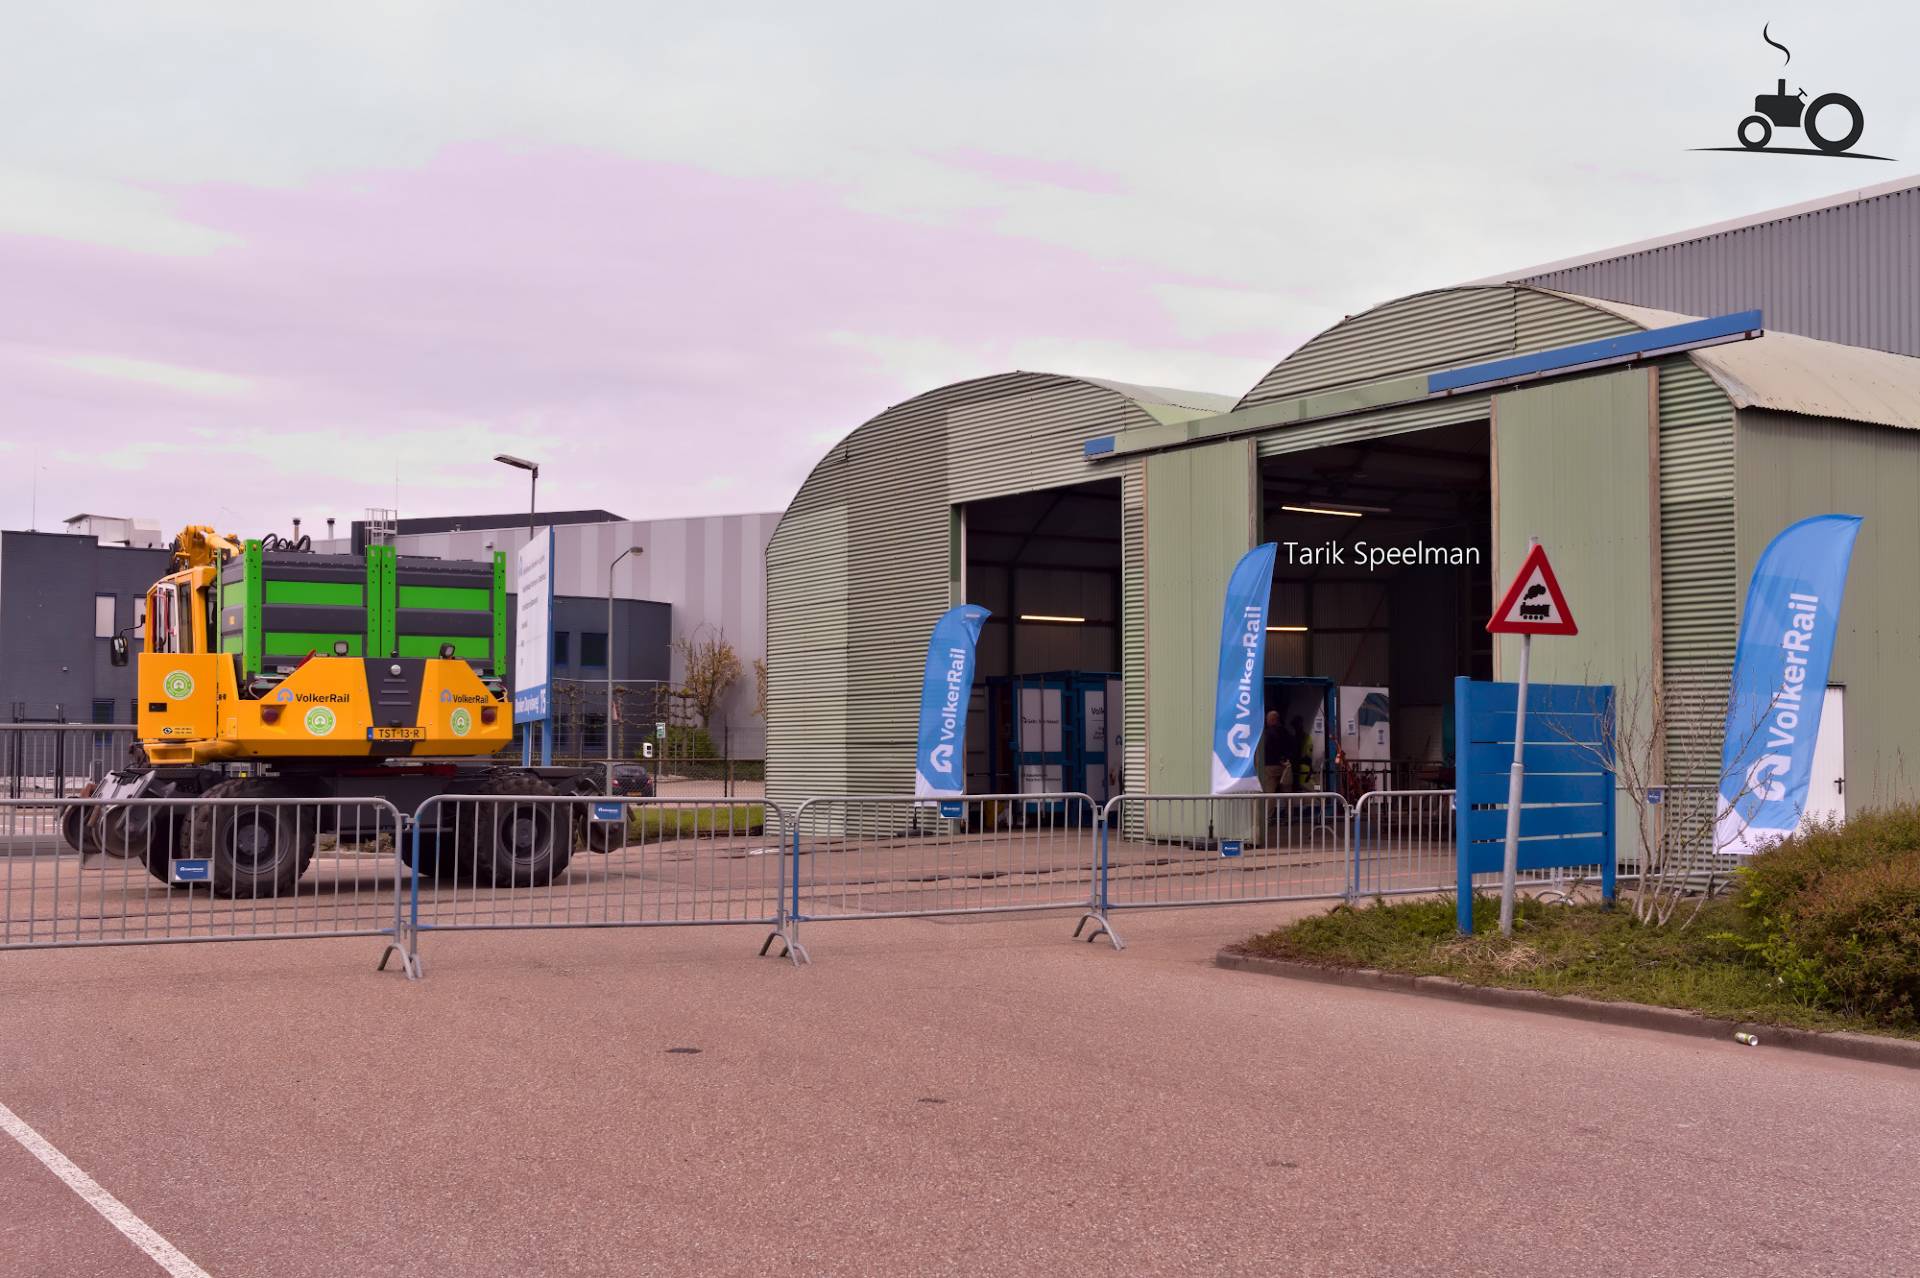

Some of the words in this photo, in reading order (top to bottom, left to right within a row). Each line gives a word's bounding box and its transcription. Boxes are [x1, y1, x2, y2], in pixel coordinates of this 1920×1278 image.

[1236, 606, 1262, 719] VolkerRail
[1768, 593, 1819, 748] VolkerRail
[296, 693, 350, 703] VolkerRail
[453, 695, 489, 703] VolkerRail
[940, 647, 967, 741] VolkerRail
[378, 729, 419, 738] TST-13-R
